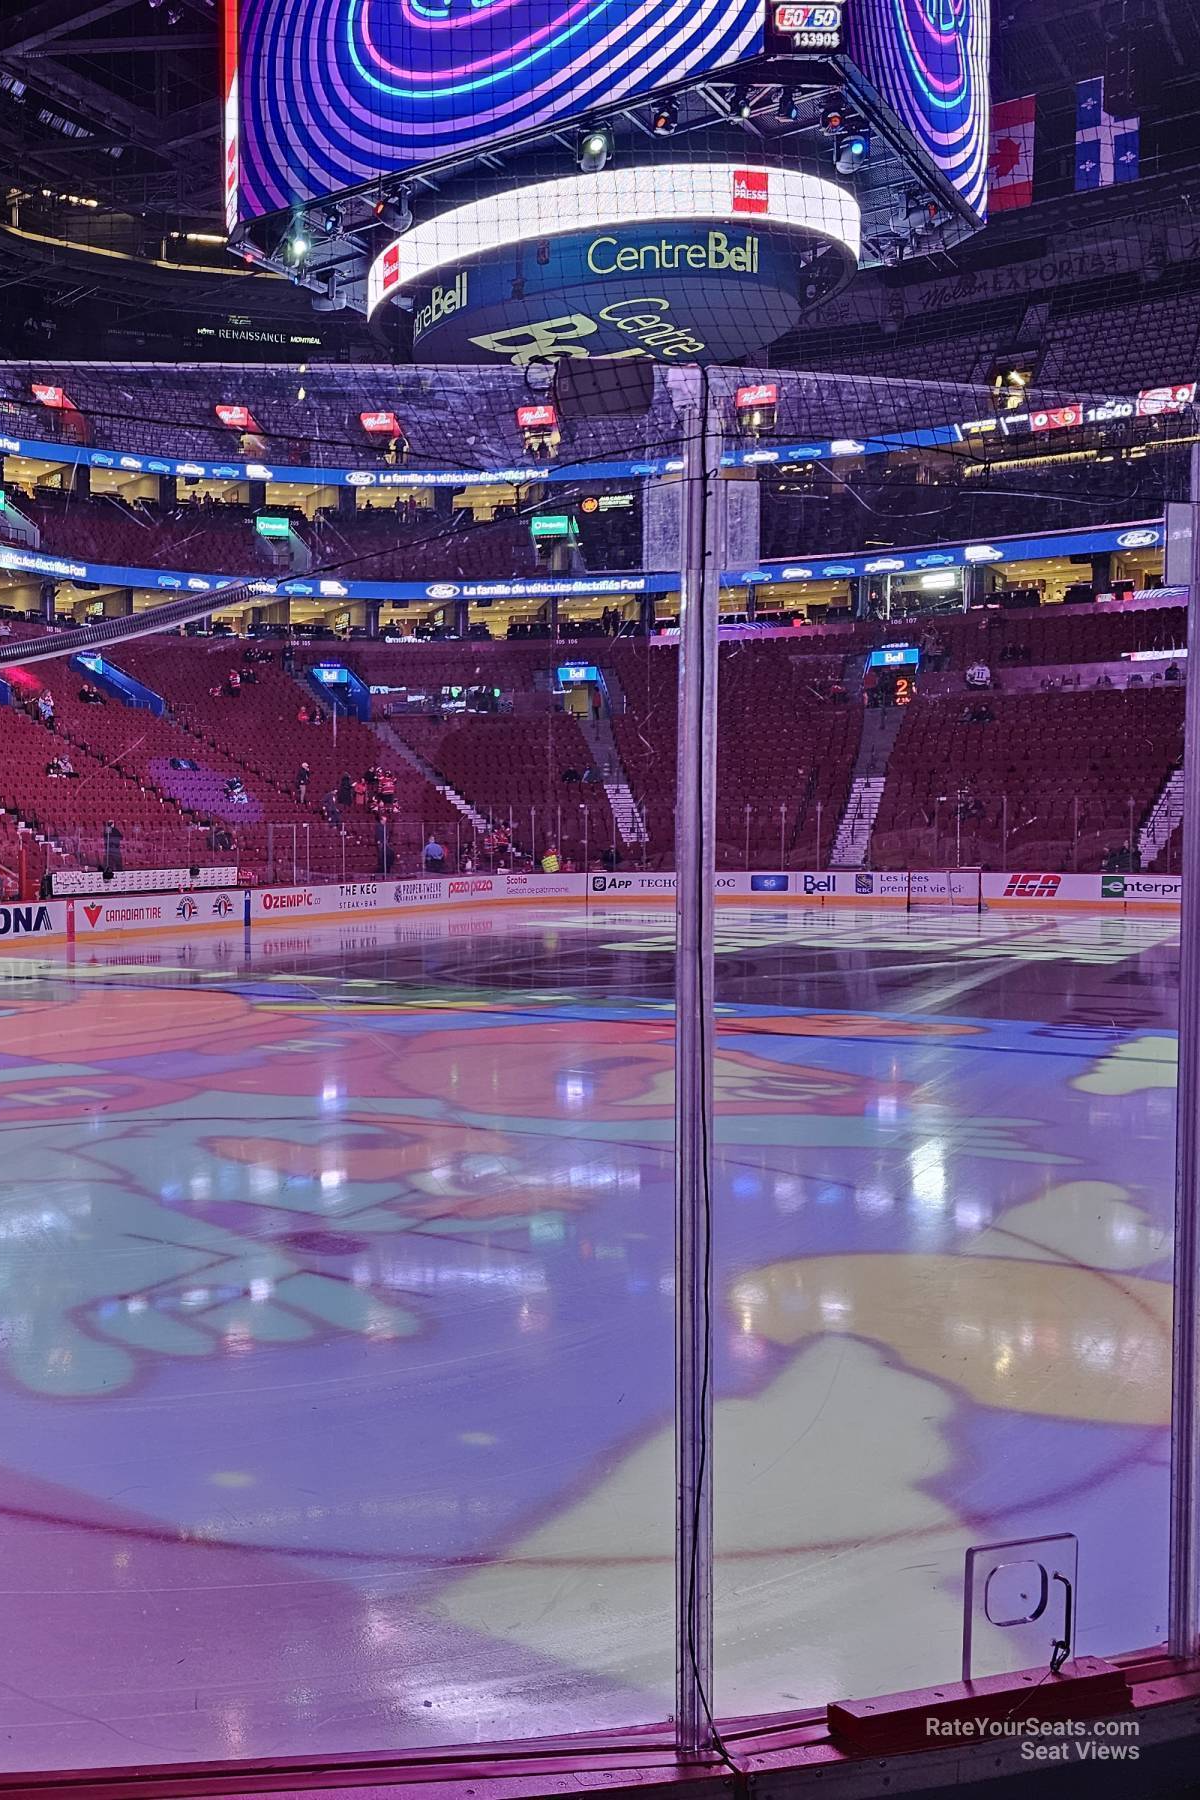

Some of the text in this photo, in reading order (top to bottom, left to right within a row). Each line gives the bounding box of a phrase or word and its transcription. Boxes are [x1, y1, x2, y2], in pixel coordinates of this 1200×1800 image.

[782, 9, 835, 26] 50/50
[793, 32, 840, 47] 13390$
[735, 179, 747, 189] LA
[735, 189, 768, 200] PRESSE
[588, 231, 760, 274] CentreBell
[414, 272, 467, 340] treBell
[219, 329, 287, 343] RENAISSANCE
[522, 408, 550, 423] Molson
[4, 439, 20, 451] Ford
[380, 474, 392, 484] La
[393, 473, 422, 484] famille
[423, 473, 433, 483] de
[435, 471, 479, 483] véhicules
[70, 565, 87, 577] Ford
[464, 586, 476, 596] La
[477, 584, 511, 595] famille
[512, 584, 525, 595] de
[526, 582, 572, 594] véhicules
[572, 580, 620, 592] électrifiés
[621, 579, 645, 590] Ford
[885, 652, 904, 663] Bell
[322, 670, 339, 681] Bell
[569, 669, 585, 678] Bell
[896, 679, 908, 695] 2
[506, 875, 528, 885] Scotia
[608, 877, 633, 889] APP
[804, 875, 836, 892] Bell
[880, 874, 898, 882] Les
[339, 883, 377, 897] THE KEG
[448, 879, 493, 899] pizza pizza
[930, 884, 946, 893] vie
[1003, 874, 1062, 897] IGA
[1111, 880, 1182, 896] enterpr
[105, 908, 144, 922] CANADIAN
[146, 906, 161, 919] TIRE
